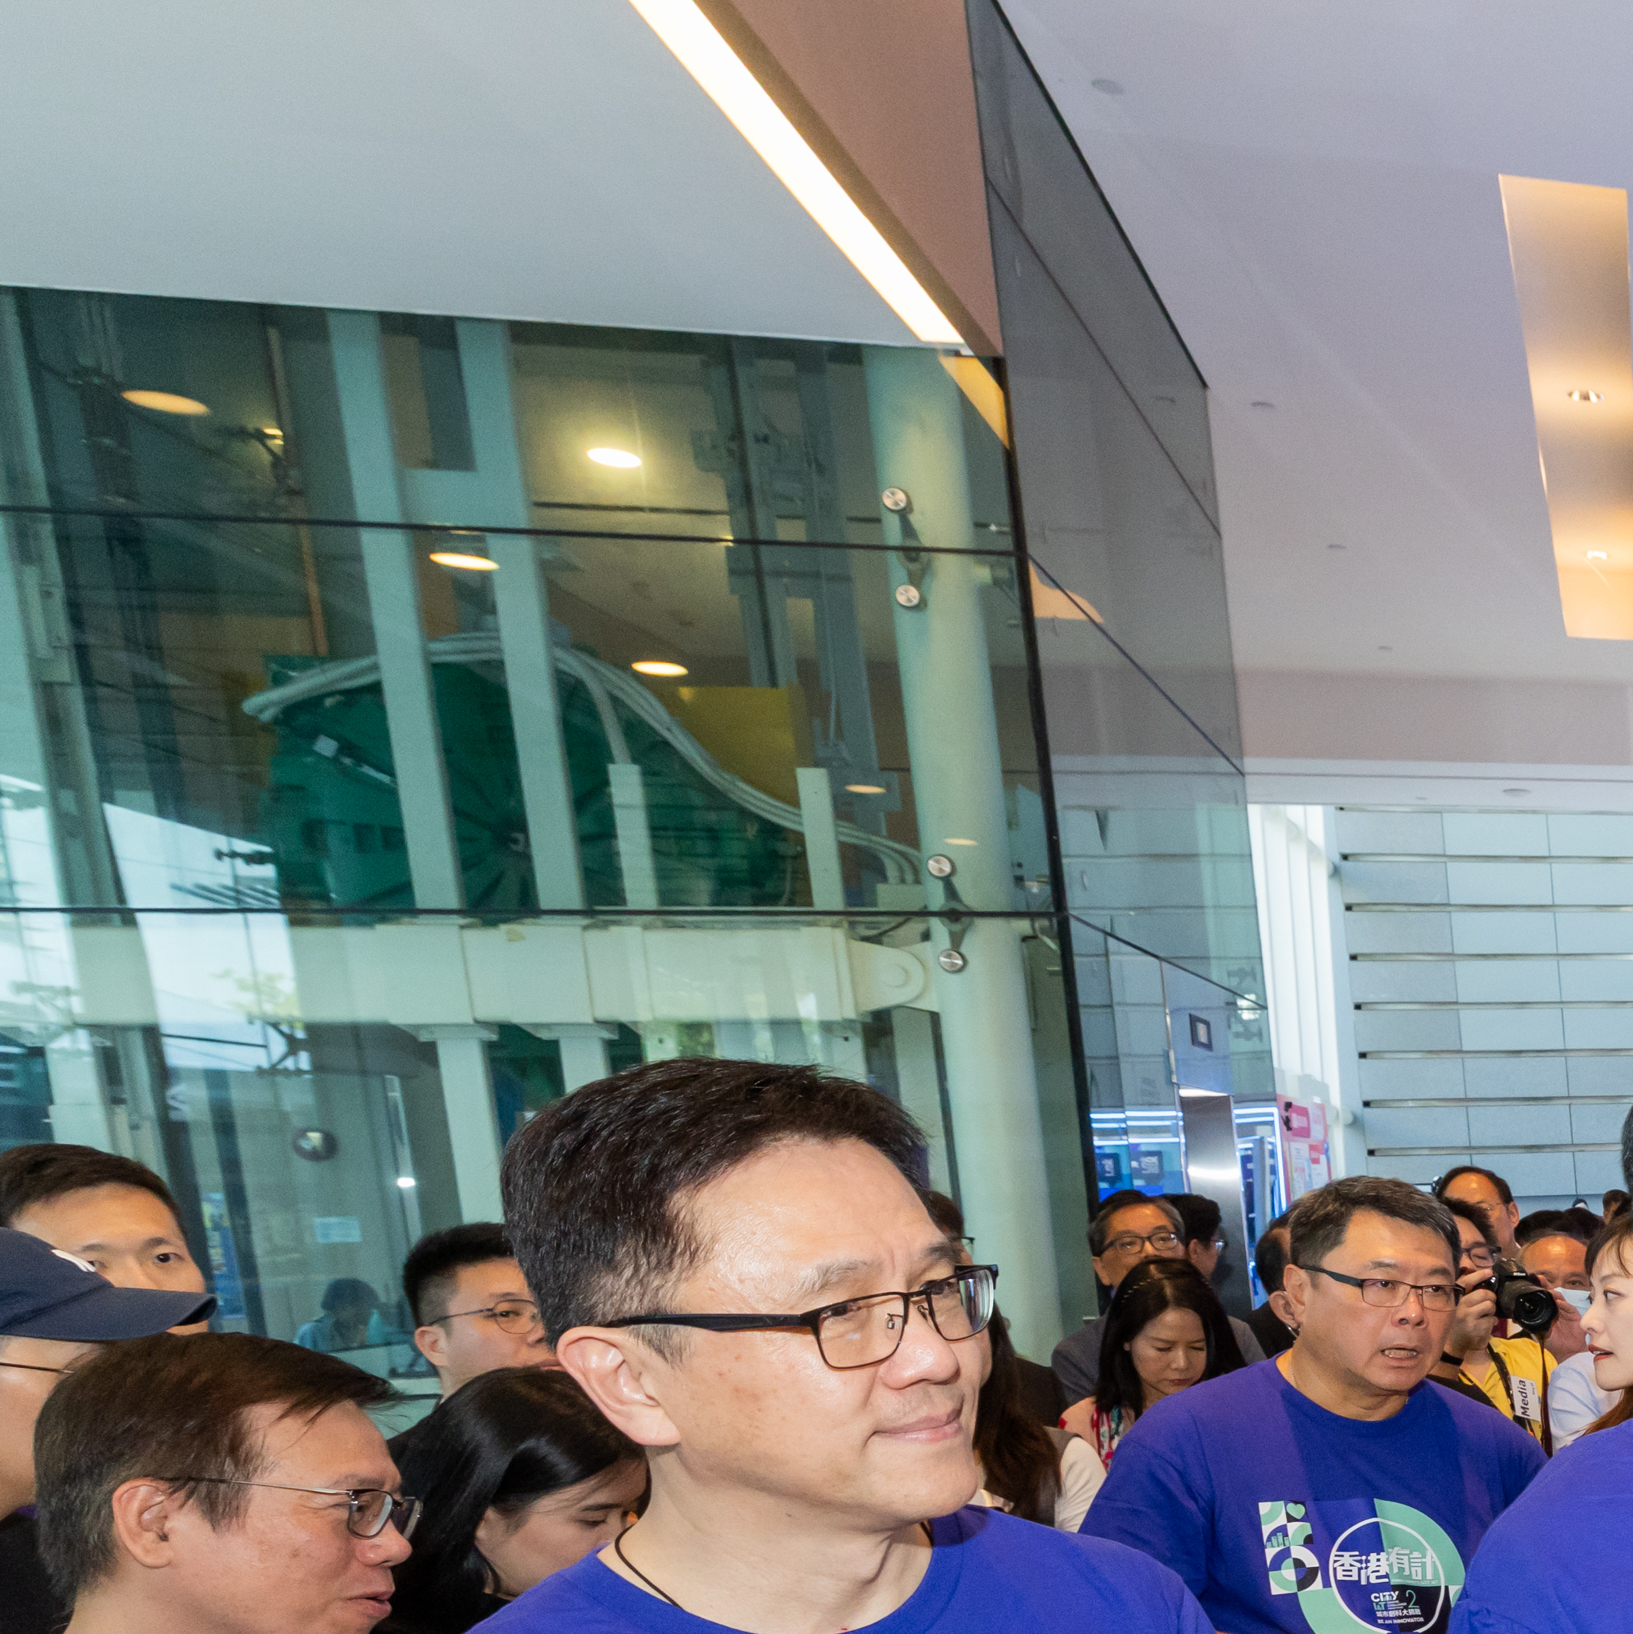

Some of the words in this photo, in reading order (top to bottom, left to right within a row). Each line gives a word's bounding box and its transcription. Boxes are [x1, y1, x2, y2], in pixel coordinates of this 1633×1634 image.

[1517, 1380, 1530, 1417] Media
[1333, 1547, 1437, 1585] 香港有計
[1371, 1591, 1399, 1602] CITY
[1406, 1590, 1419, 1608] 2
